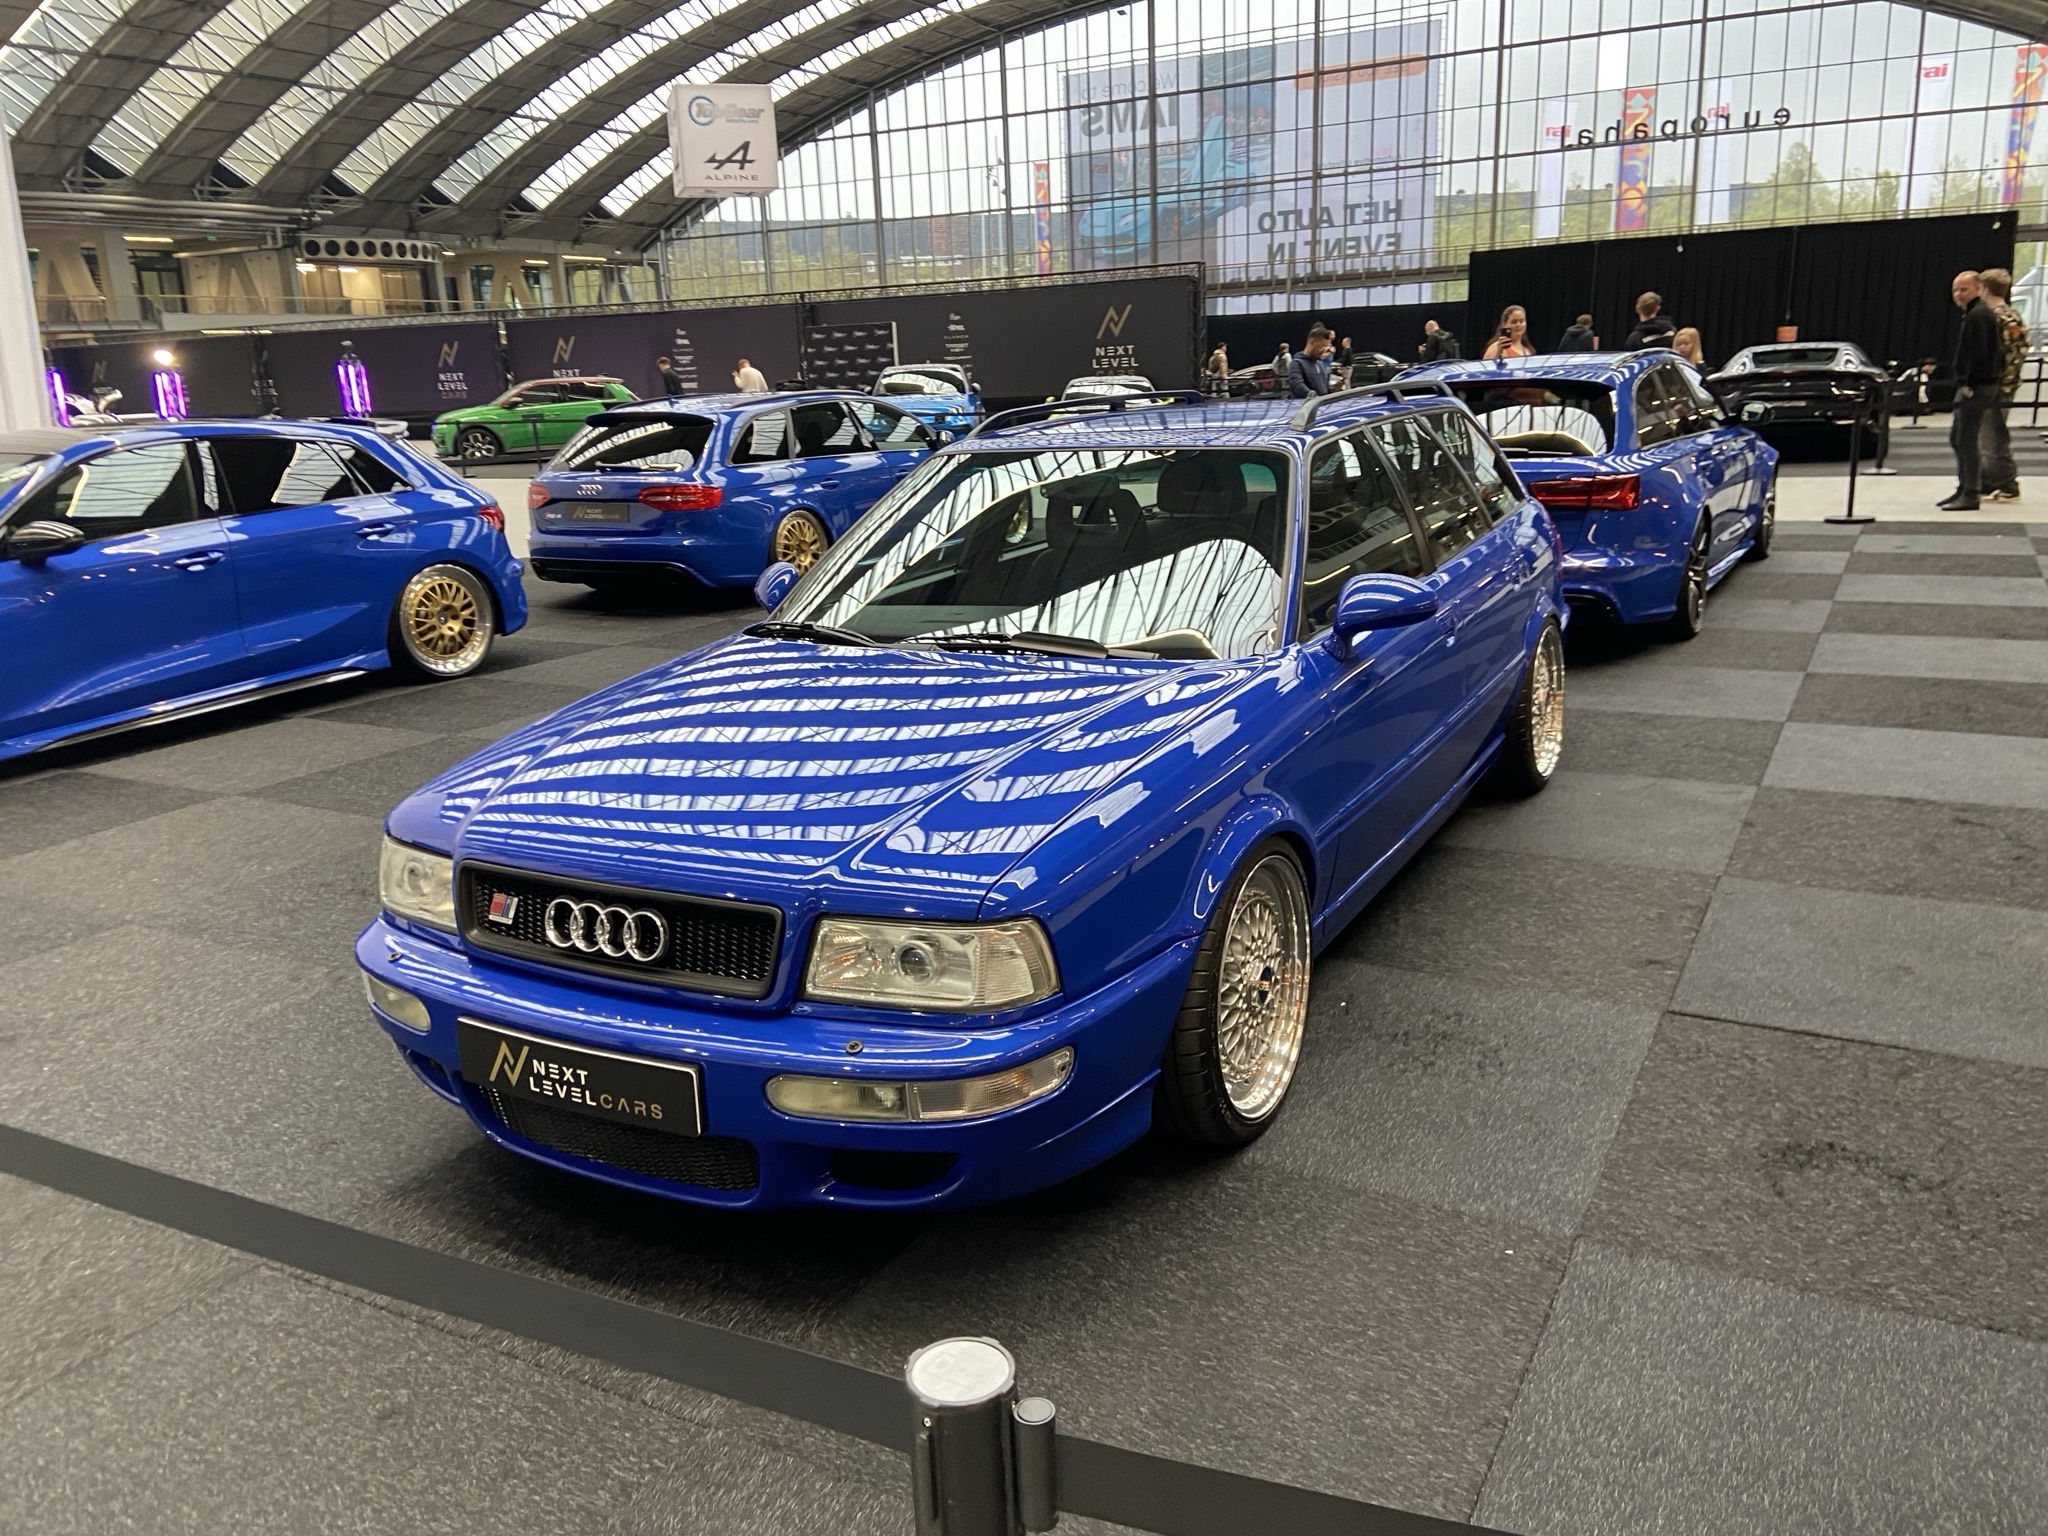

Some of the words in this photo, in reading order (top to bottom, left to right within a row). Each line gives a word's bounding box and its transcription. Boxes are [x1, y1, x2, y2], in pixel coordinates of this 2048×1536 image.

[704, 174, 760, 182] ALPINE
[1095, 345, 1135, 356] NEXT
[1092, 357, 1139, 369] LEVEL
[438, 372, 464, 381] NEXT
[552, 369, 580, 378] NEXT
[437, 381, 469, 391] LEVEL
[532, 1059, 588, 1086] NEXT
